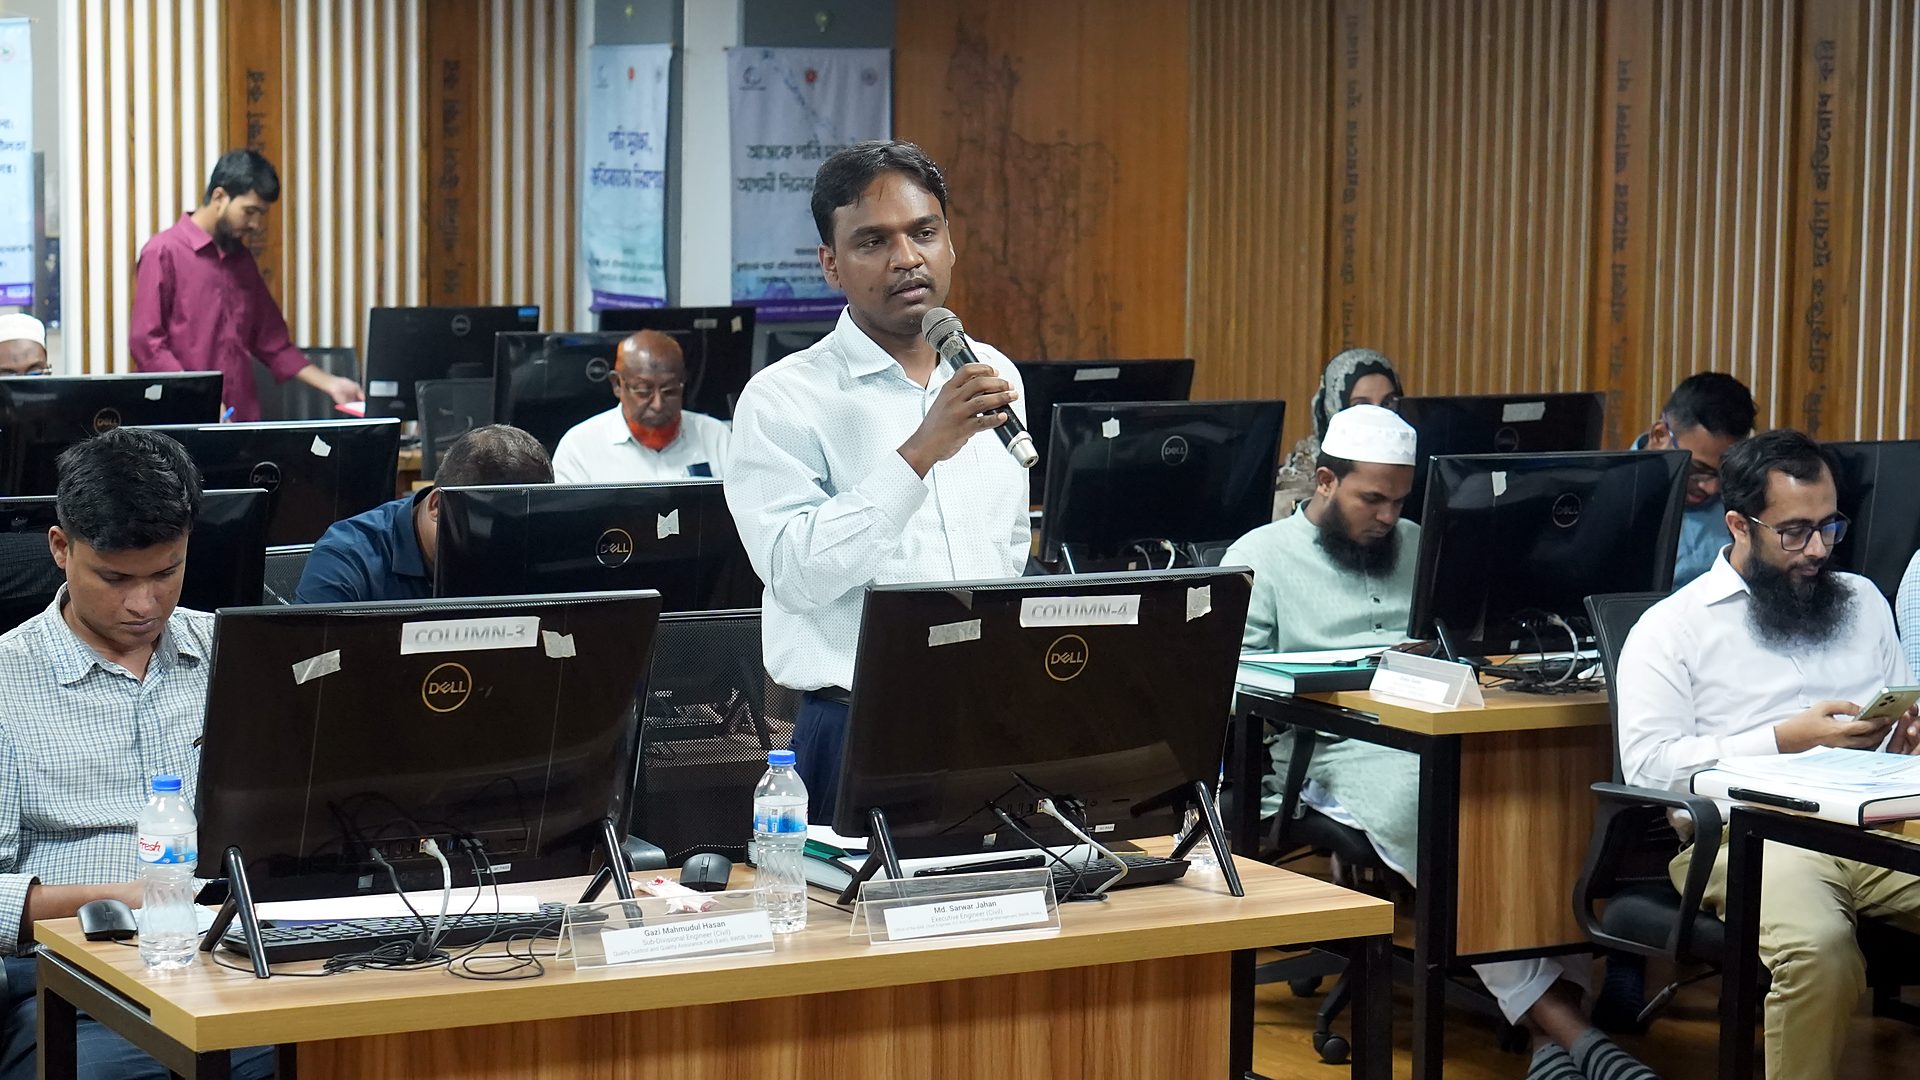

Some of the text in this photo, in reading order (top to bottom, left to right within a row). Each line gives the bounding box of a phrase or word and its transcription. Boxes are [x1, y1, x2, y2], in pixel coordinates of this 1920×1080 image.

[1809, 90, 1833, 191] প্রতিরোধ
[1804, 274, 1832, 374] প্রাকৃতিক
[1165, 446, 1186, 456] DELL
[600, 543, 629, 554] DELL
[1030, 601, 1130, 620] COLUMN-4
[415, 624, 527, 645] COLUMN-3
[1050, 651, 1085, 665] DELL
[428, 681, 468, 694] DELL
[140, 837, 161, 852] Fresh
[933, 901, 996, 914] Md. Sarwar Jahan
[931, 914, 959, 923] Executive
[960, 912, 985, 922] Engineer
[644, 921, 726, 937] Gazi Mahmudul Hasan
[686, 932, 712, 942] Engineer
